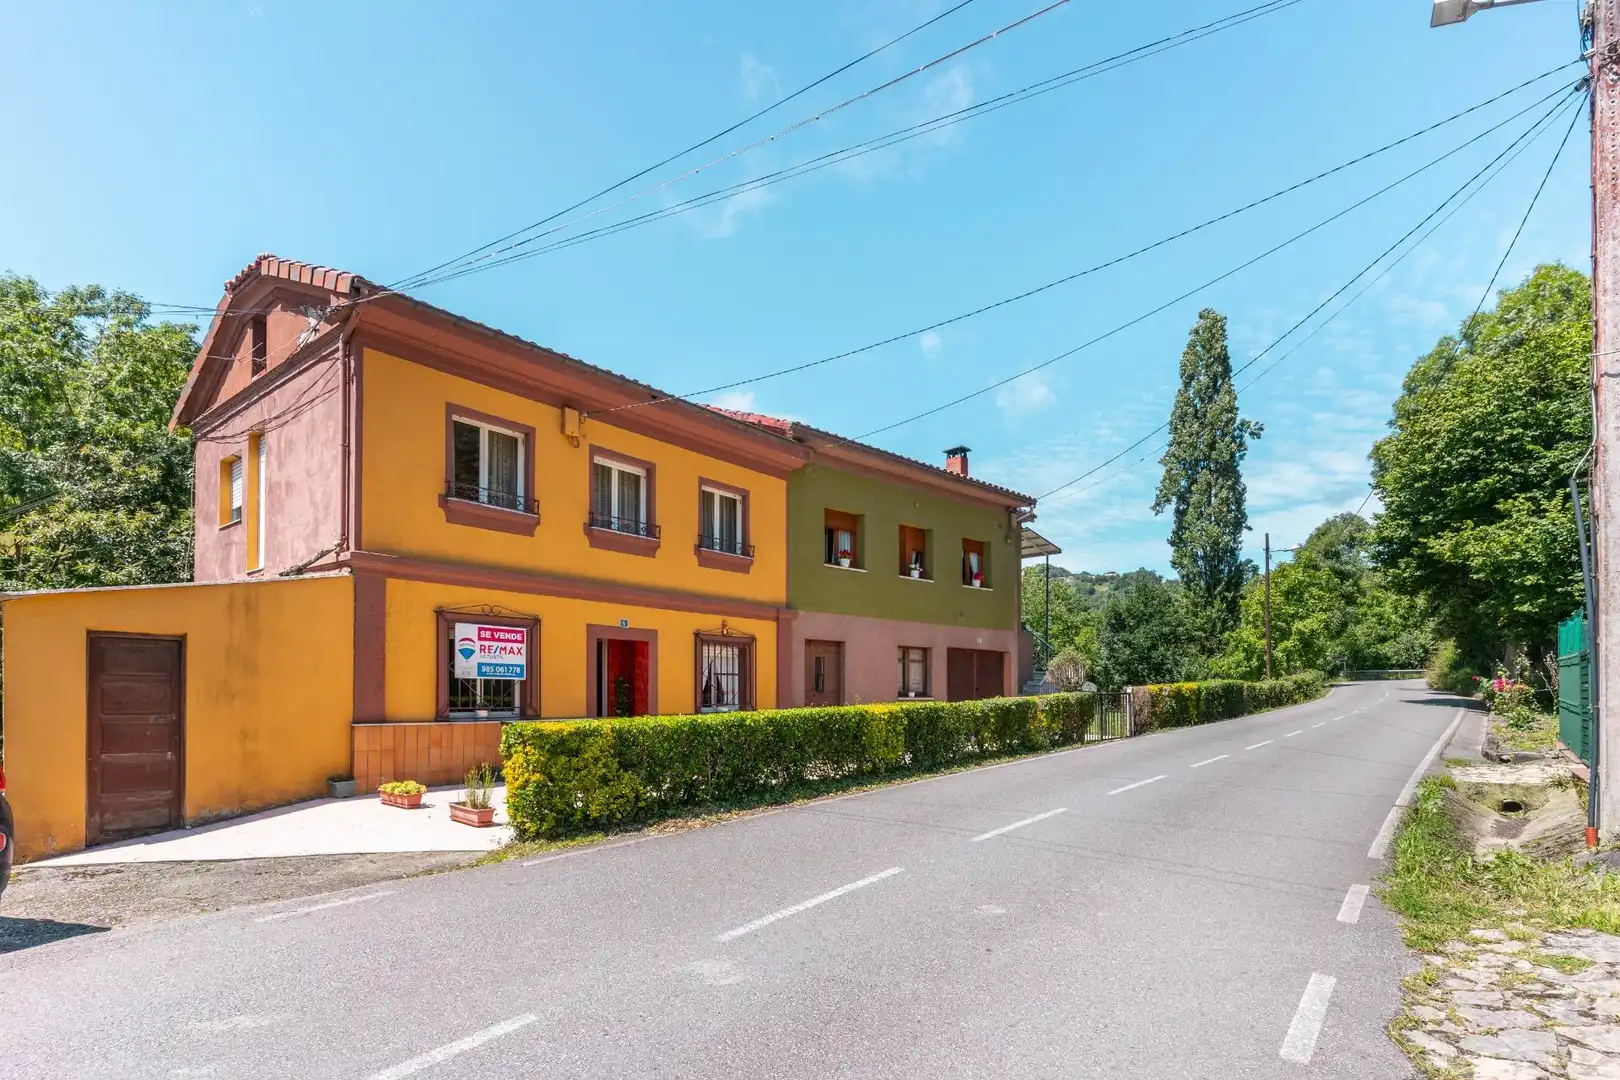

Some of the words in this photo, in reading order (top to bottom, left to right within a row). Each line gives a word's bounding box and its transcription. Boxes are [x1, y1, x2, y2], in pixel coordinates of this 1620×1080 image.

[494, 632, 522, 640] VENDE
[480, 644, 523, 655] RE/MAX
[482, 665, 494, 673] 985
